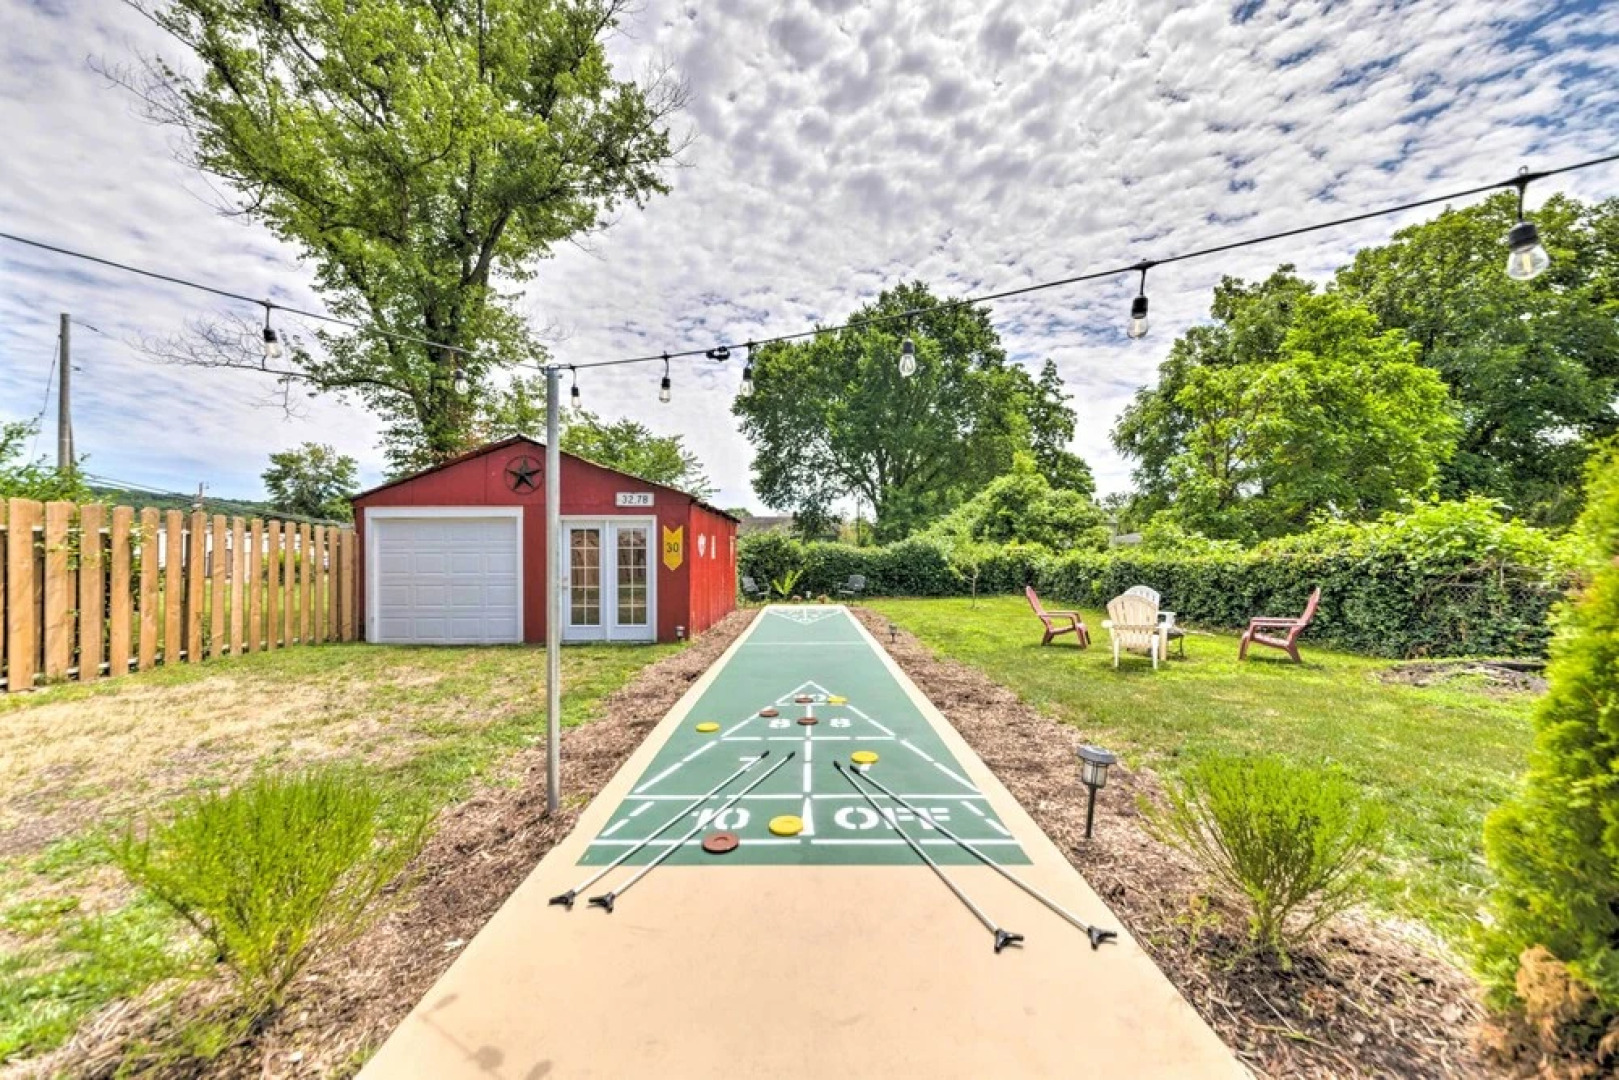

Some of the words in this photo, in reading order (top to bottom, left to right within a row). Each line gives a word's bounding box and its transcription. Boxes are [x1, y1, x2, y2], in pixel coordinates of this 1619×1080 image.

[622, 495, 649, 504] 32.78
[666, 542, 679, 553] 30
[833, 807, 951, 830] OFF
